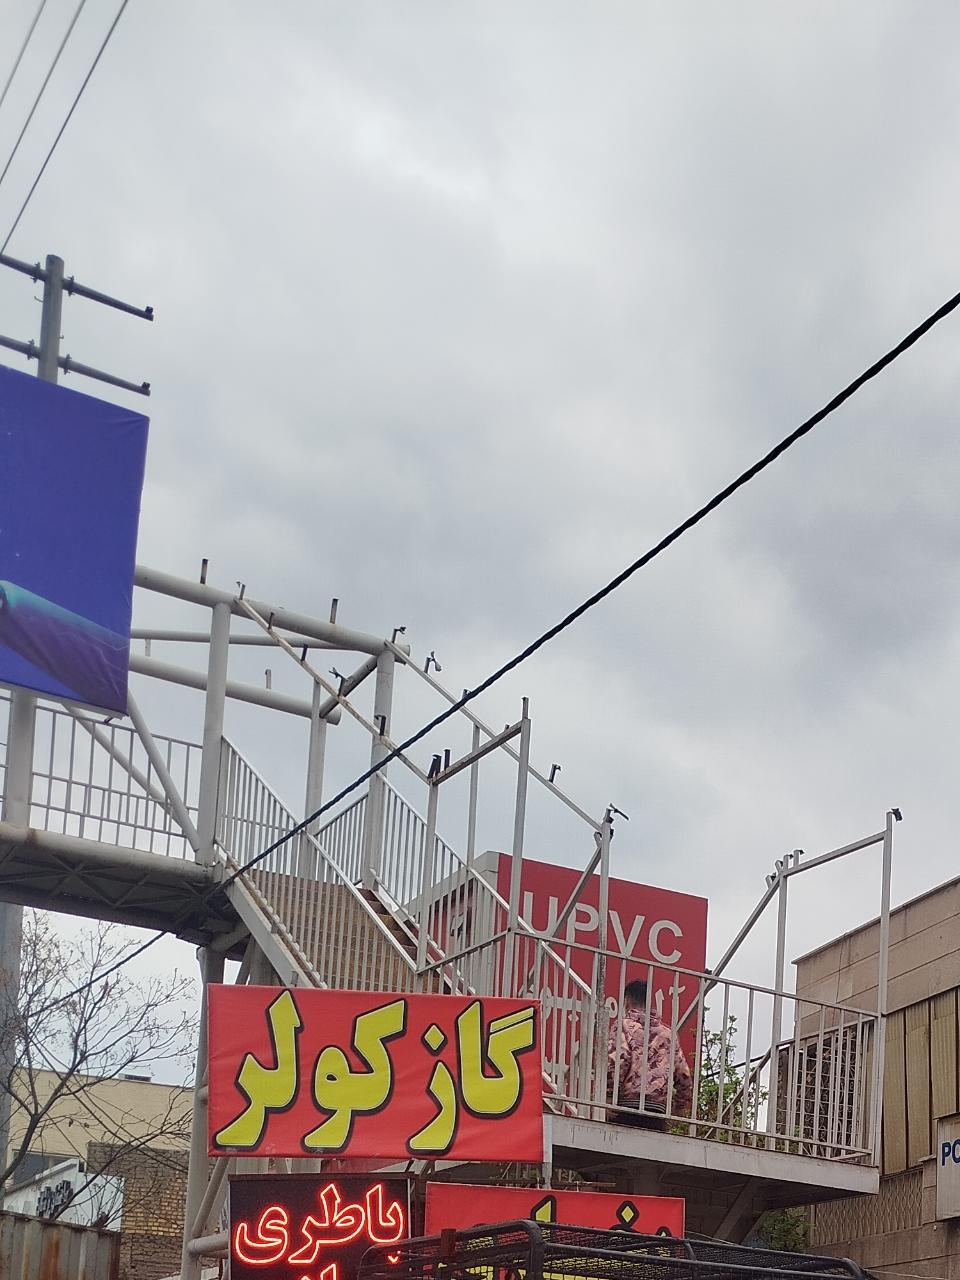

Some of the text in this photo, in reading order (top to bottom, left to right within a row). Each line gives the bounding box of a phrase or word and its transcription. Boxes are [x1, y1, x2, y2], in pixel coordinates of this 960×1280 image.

[523, 890, 684, 965] UPVC
[213, 988, 537, 1155] گاز کولر
